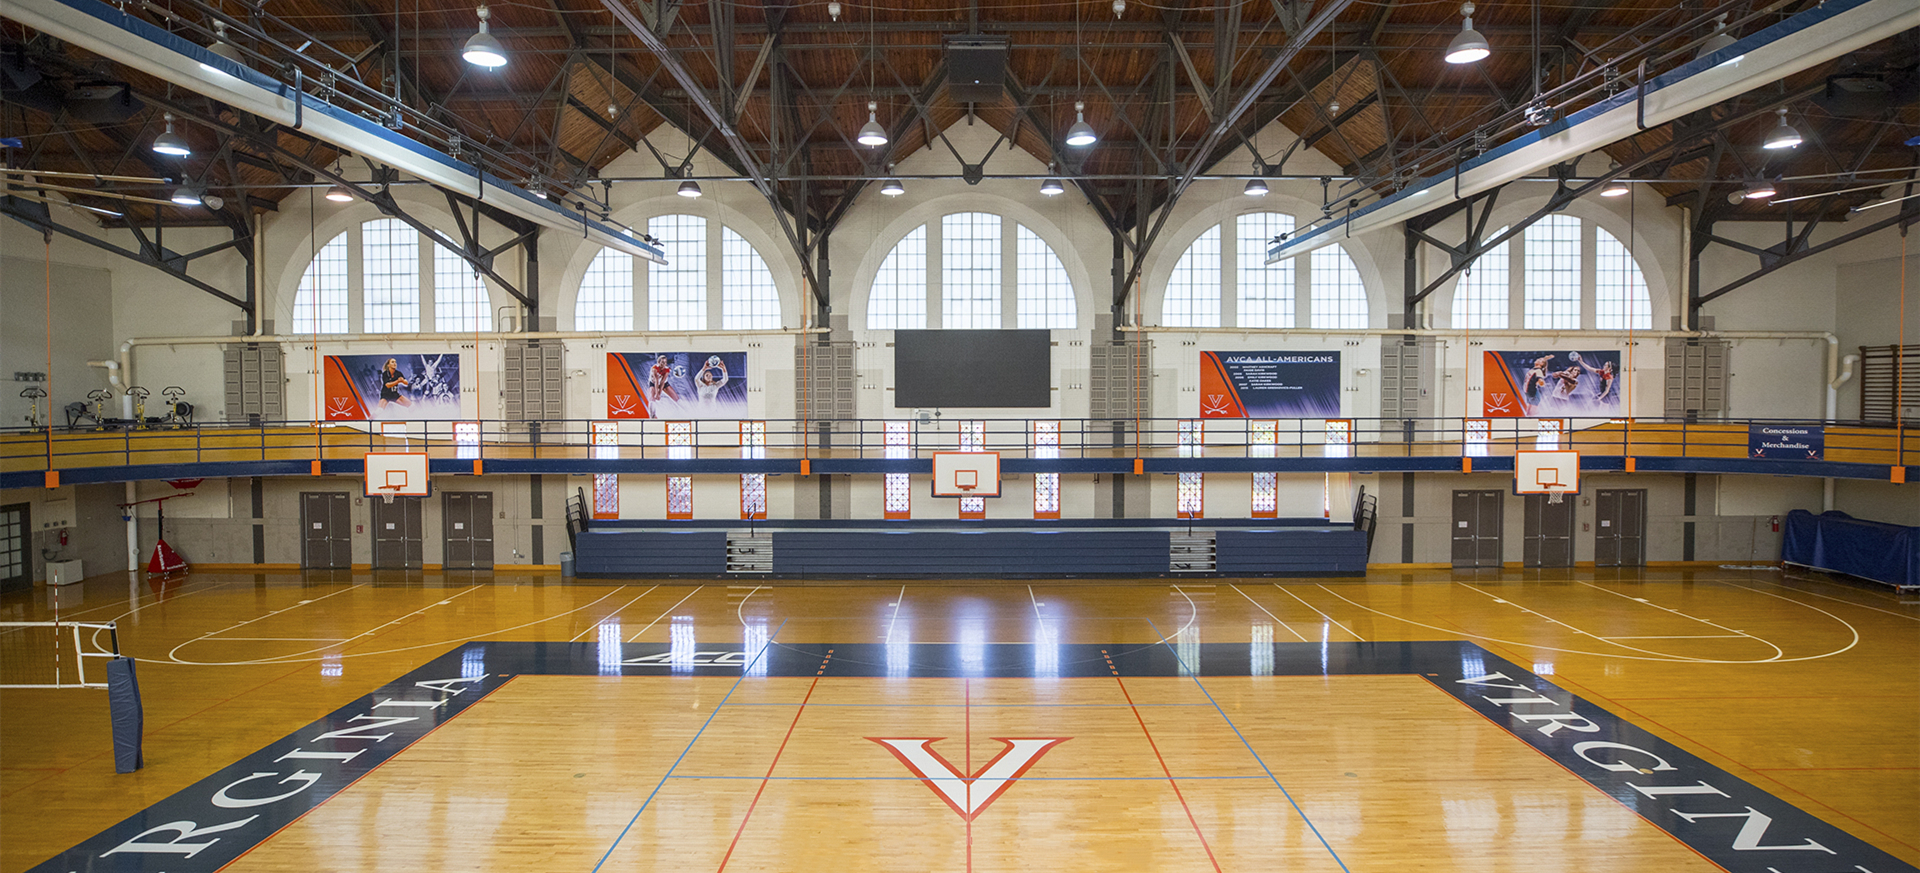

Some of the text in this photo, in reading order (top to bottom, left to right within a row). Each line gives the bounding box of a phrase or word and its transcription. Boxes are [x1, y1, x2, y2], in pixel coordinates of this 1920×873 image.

[1761, 441, 1810, 449] Merchandise
[67, 673, 490, 873] RGINIA
[862, 737, 1075, 822] V
[1455, 671, 1875, 873] VIRGIN
